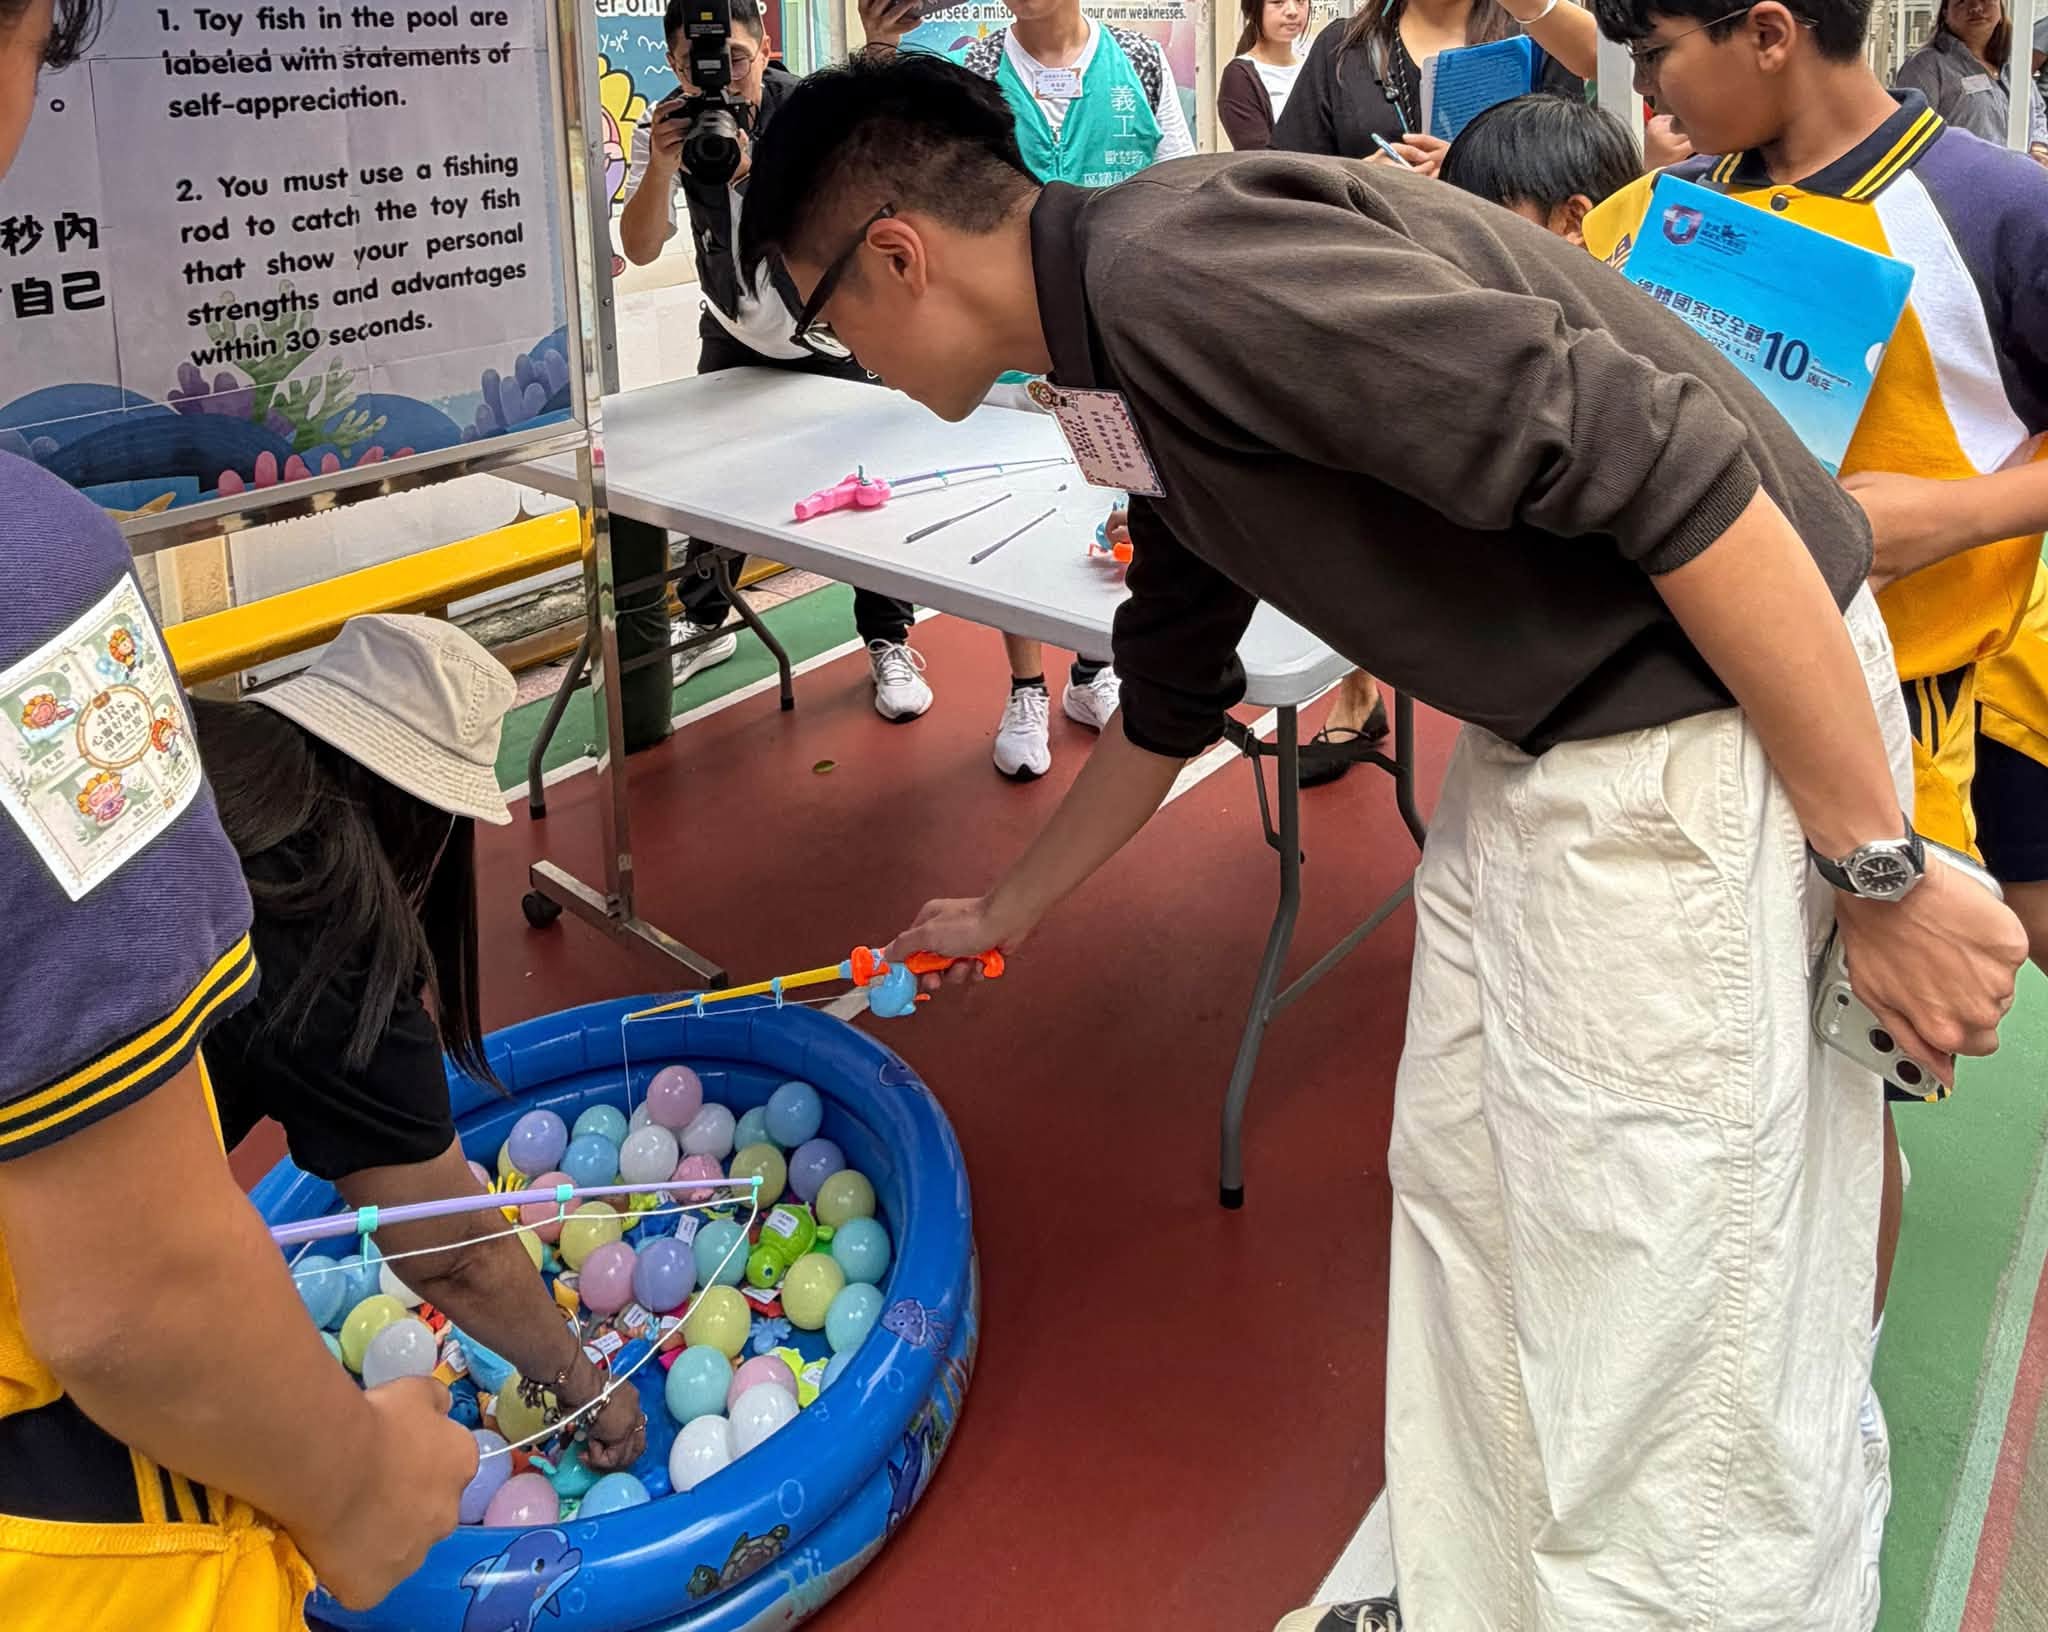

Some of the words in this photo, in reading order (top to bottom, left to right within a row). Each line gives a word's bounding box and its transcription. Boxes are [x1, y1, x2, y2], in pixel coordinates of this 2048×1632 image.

[158, 8, 180, 31] 1.
[194, 8, 243, 36] Toy
[256, 6, 305, 31] fish
[318, 6, 342, 30] in
[351, 6, 394, 28] the
[406, 6, 458, 32] pool
[470, 10, 508, 27] are
[1107, 8, 1127, 19] own
[1129, 4, 1187, 19] weaknesses.
[162, 47, 272, 75] labeled
[280, 47, 337, 71] with
[343, 45, 480, 70] statements
[487, 42, 511, 64] of
[168, 85, 407, 120] self-appreciation.
[1110, 84, 1137, 137] 義工
[176, 179, 203, 202] 2.
[218, 176, 267, 198] You
[284, 168, 348, 192] must
[360, 164, 404, 185] use
[416, 163, 432, 180] a
[443, 152, 519, 177] fishing
[181, 216, 229, 244] rod
[246, 216, 275, 236] to
[292, 205, 360, 232] catch
[375, 199, 417, 222] the
[431, 195, 468, 219] toy
[481, 188, 521, 211] fish
[183, 258, 245, 285] that
[267, 251, 335, 276] show
[353, 240, 408, 270] your
[426, 222, 523, 259] personal
[11, 270, 105, 319] 自己
[187, 291, 319, 327] strengths
[332, 278, 379, 307] and
[391, 261, 526, 296] advantages
[191, 335, 276, 367] within
[286, 328, 321, 352] 30
[329, 310, 433, 345] seconds.
[1763, 331, 1810, 381] 10
